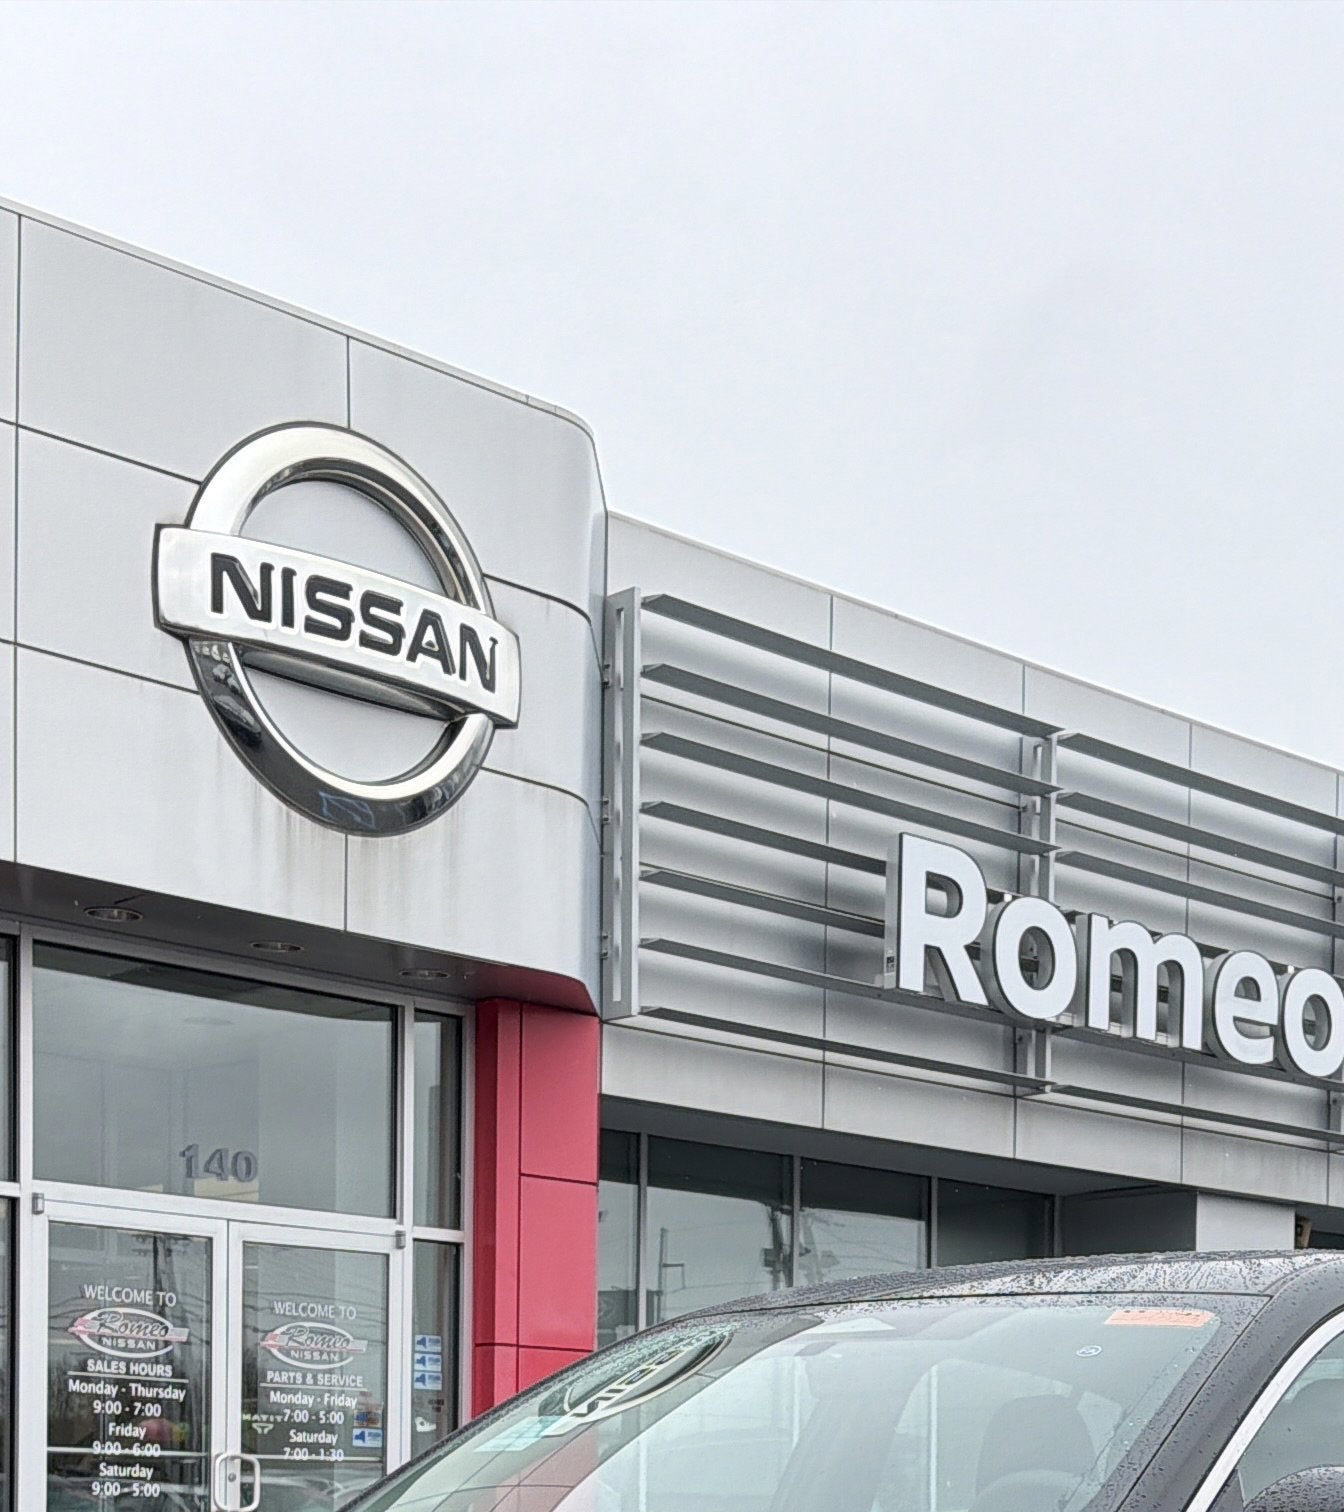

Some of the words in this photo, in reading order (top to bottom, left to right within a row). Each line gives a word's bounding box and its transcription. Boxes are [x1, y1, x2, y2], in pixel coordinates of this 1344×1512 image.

[209, 552, 498, 694] NISSAN
[179, 1144, 258, 1183] 140
[83, 1284, 153, 1304] WELCOME
[156, 1292, 177, 1307] TO
[274, 1301, 335, 1319] WELCOME
[338, 1306, 357, 1320] TO
[90, 1310, 171, 1338] Romeo
[102, 1337, 156, 1350] NISSAN
[284, 1326, 352, 1350] Romeo
[290, 1350, 340, 1362] NISSAN
[87, 1359, 126, 1373] SALES
[130, 1362, 172, 1377] HOURS
[266, 1371, 303, 1385] PARTS
[306, 1371, 314, 1385] &
[317, 1373, 363, 1387] SERVICE
[68, 1379, 118, 1397] Monday
[129, 1383, 186, 1401] Thursday
[270, 1390, 315, 1407] Monday
[323, 1393, 357, 1409] Friday
[93, 1400, 122, 1415] 9:00
[133, 1402, 161, 1417] 7:00
[283, 1409, 309, 1423] 7:00
[319, 1411, 344, 1425] 5:00
[108, 1423, 146, 1440] Friday
[289, 1429, 338, 1446] Saturday
[92, 1441, 122, 1455] 9:00
[133, 1443, 161, 1457] 6:00
[283, 1448, 309, 1461] 7:00
[319, 1449, 345, 1462] 1:30
[99, 1462, 154, 1479] Saturday
[91, 1482, 121, 1497] 9:00
[132, 1483, 160, 1498] 5:00
